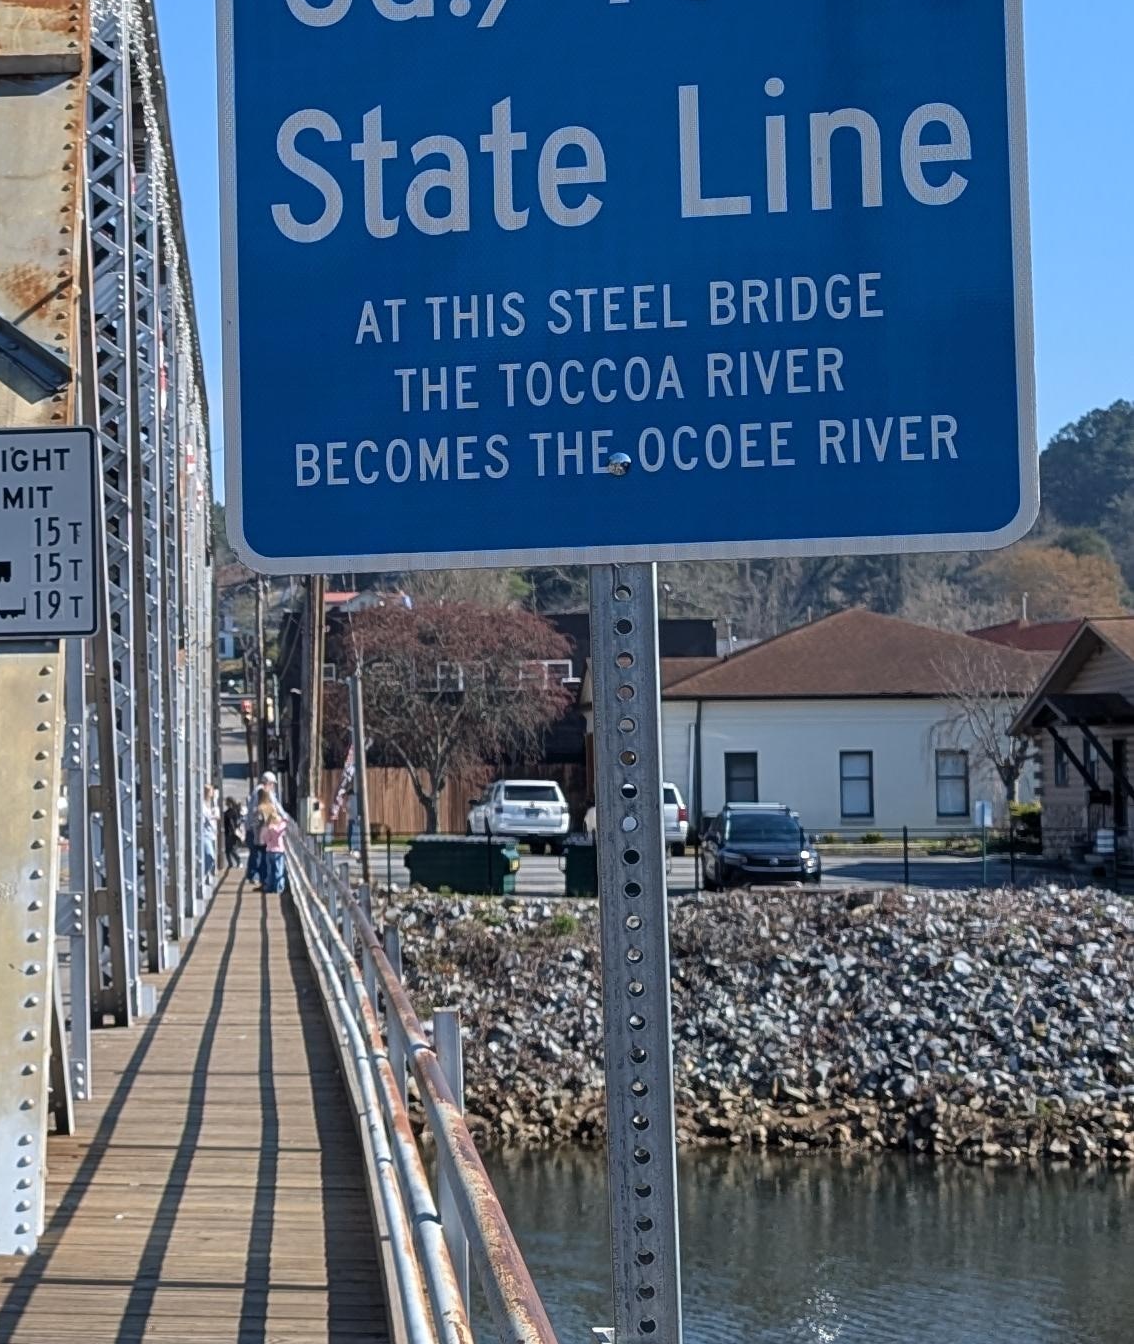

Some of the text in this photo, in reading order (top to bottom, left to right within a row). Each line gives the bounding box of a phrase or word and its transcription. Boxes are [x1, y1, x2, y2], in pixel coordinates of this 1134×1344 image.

[270, 77, 972, 243] State Line
[355, 272, 884, 345] AT THIS STEEL BRIDGE
[394, 347, 844, 413] THE TOCCOA RIVER
[295, 414, 958, 487] BECOMES THE OCOEE RIVER
